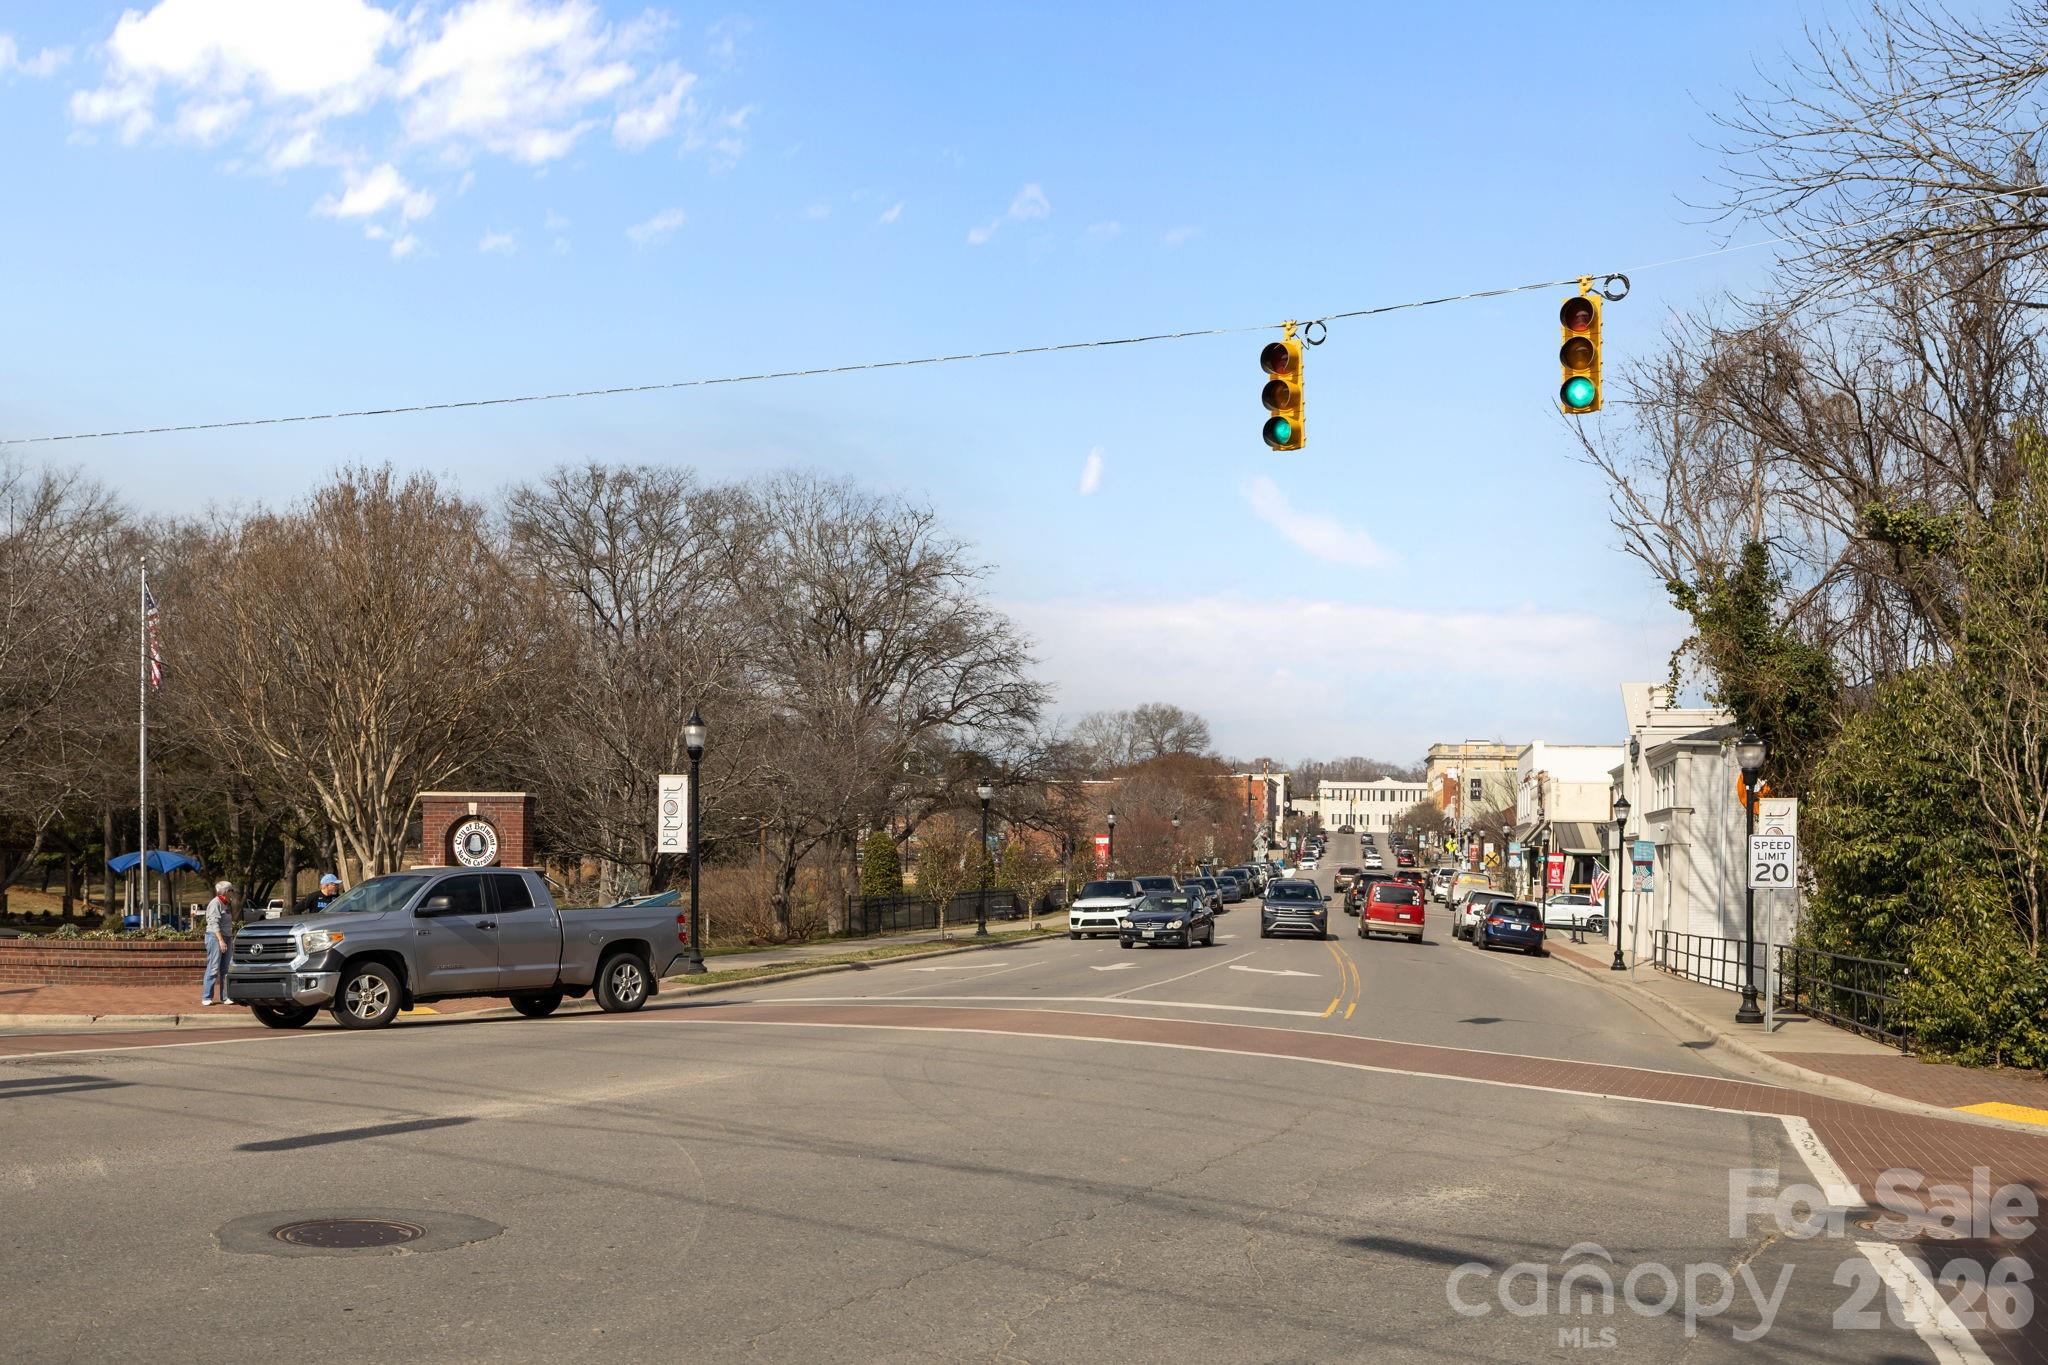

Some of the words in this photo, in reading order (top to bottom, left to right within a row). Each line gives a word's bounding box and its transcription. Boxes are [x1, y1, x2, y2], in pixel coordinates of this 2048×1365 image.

[455, 829, 466, 845] City
[474, 822, 495, 846] Belmont
[1753, 841, 1791, 850] SPEED
[457, 850, 472, 865] North
[473, 850, 495, 867] Carolina
[1757, 852, 1787, 860] LIMIT
[1755, 863, 1788, 882] 20
